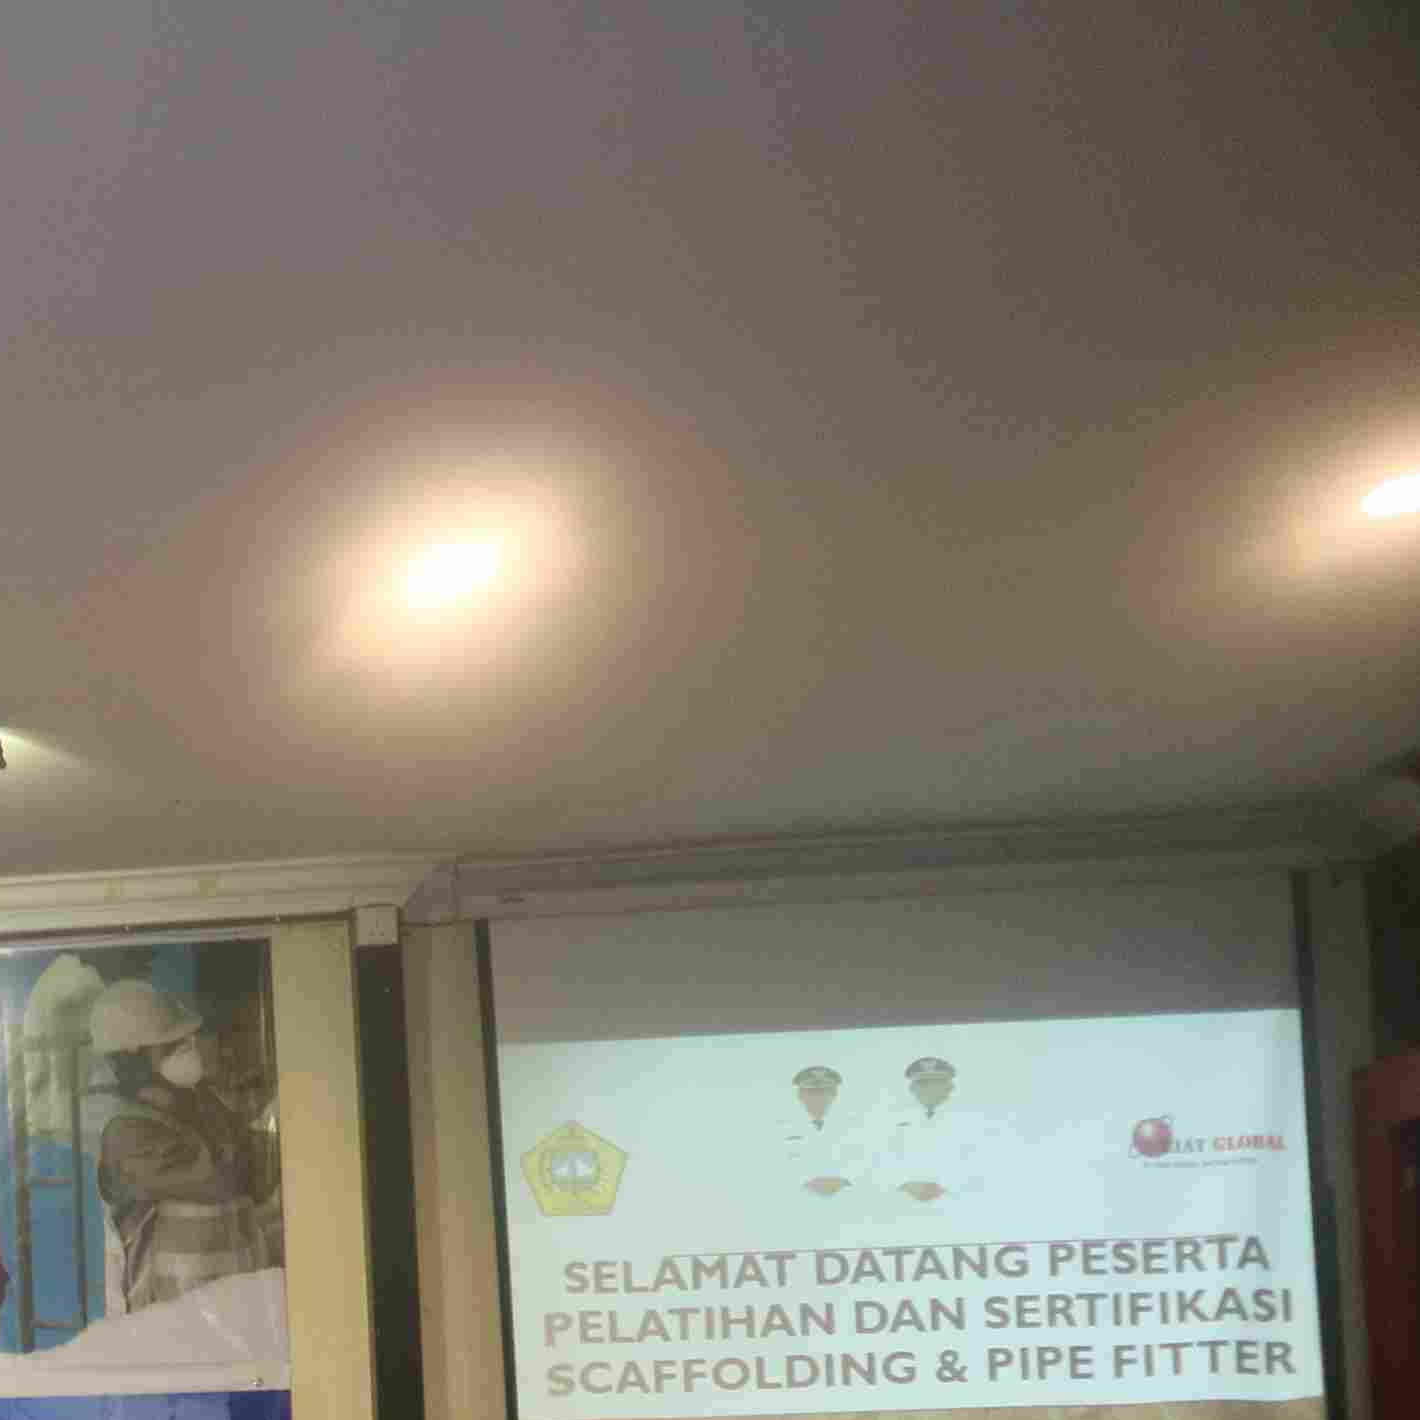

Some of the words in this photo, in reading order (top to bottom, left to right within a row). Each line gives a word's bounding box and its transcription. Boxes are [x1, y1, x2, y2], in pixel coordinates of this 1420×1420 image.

[563, 1252, 797, 1295] SELAMAT
[815, 1244, 1030, 1286] DATANG
[1048, 1235, 1271, 1277] PESERTA
[543, 1302, 836, 1348] PELATIHAN
[855, 1297, 967, 1334] DAN
[984, 1287, 1293, 1329] SERTIFIKASI
[546, 1351, 918, 1398] SCAFFOLDING
[935, 1349, 968, 1384] &
[987, 1345, 1096, 1382] PIPE
[1113, 1339, 1298, 1379] FITTER
